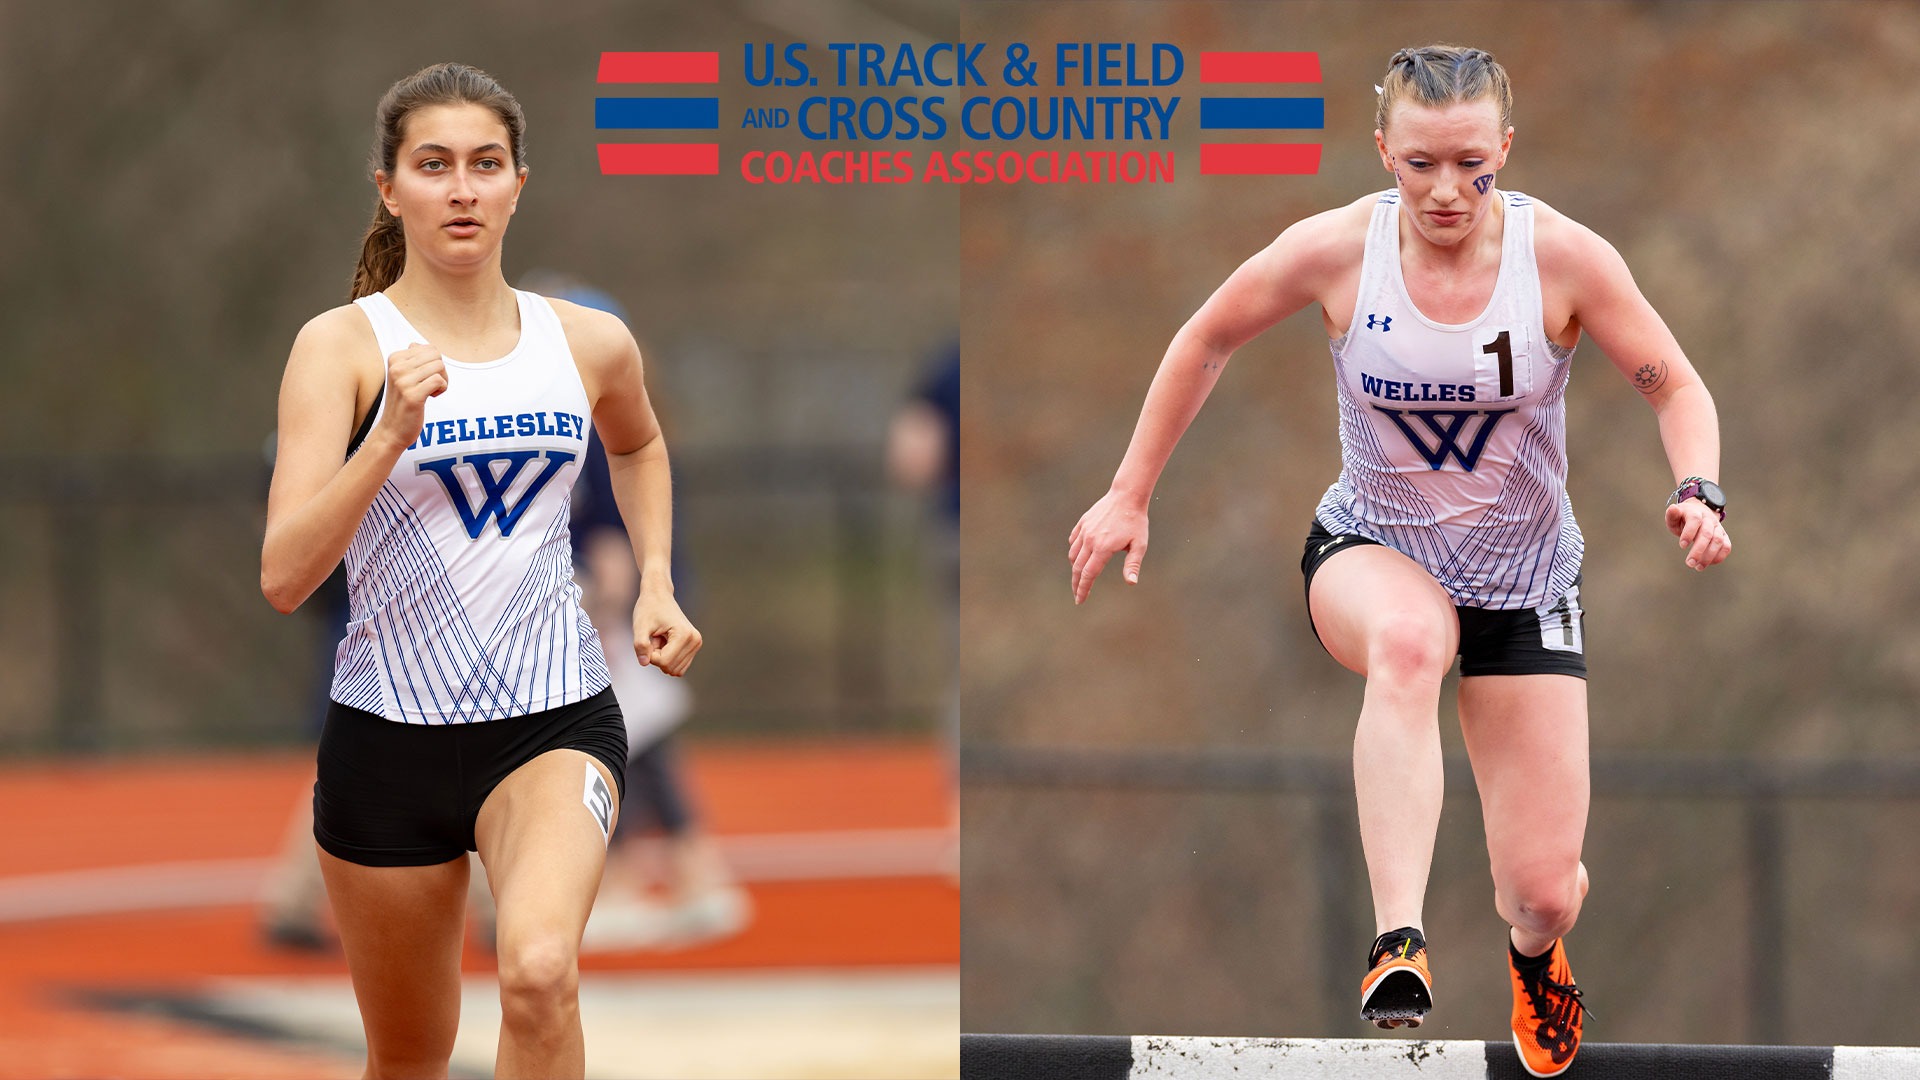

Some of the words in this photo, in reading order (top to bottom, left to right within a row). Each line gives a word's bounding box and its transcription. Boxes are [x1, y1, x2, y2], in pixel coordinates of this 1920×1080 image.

[1361, 372, 1476, 402] WELLES
[1482, 330, 1514, 398] 1
[1369, 401, 1520, 473] W
[414, 446, 579, 543] W
[1547, 593, 1574, 647] 1
[589, 775, 612, 834] 5
